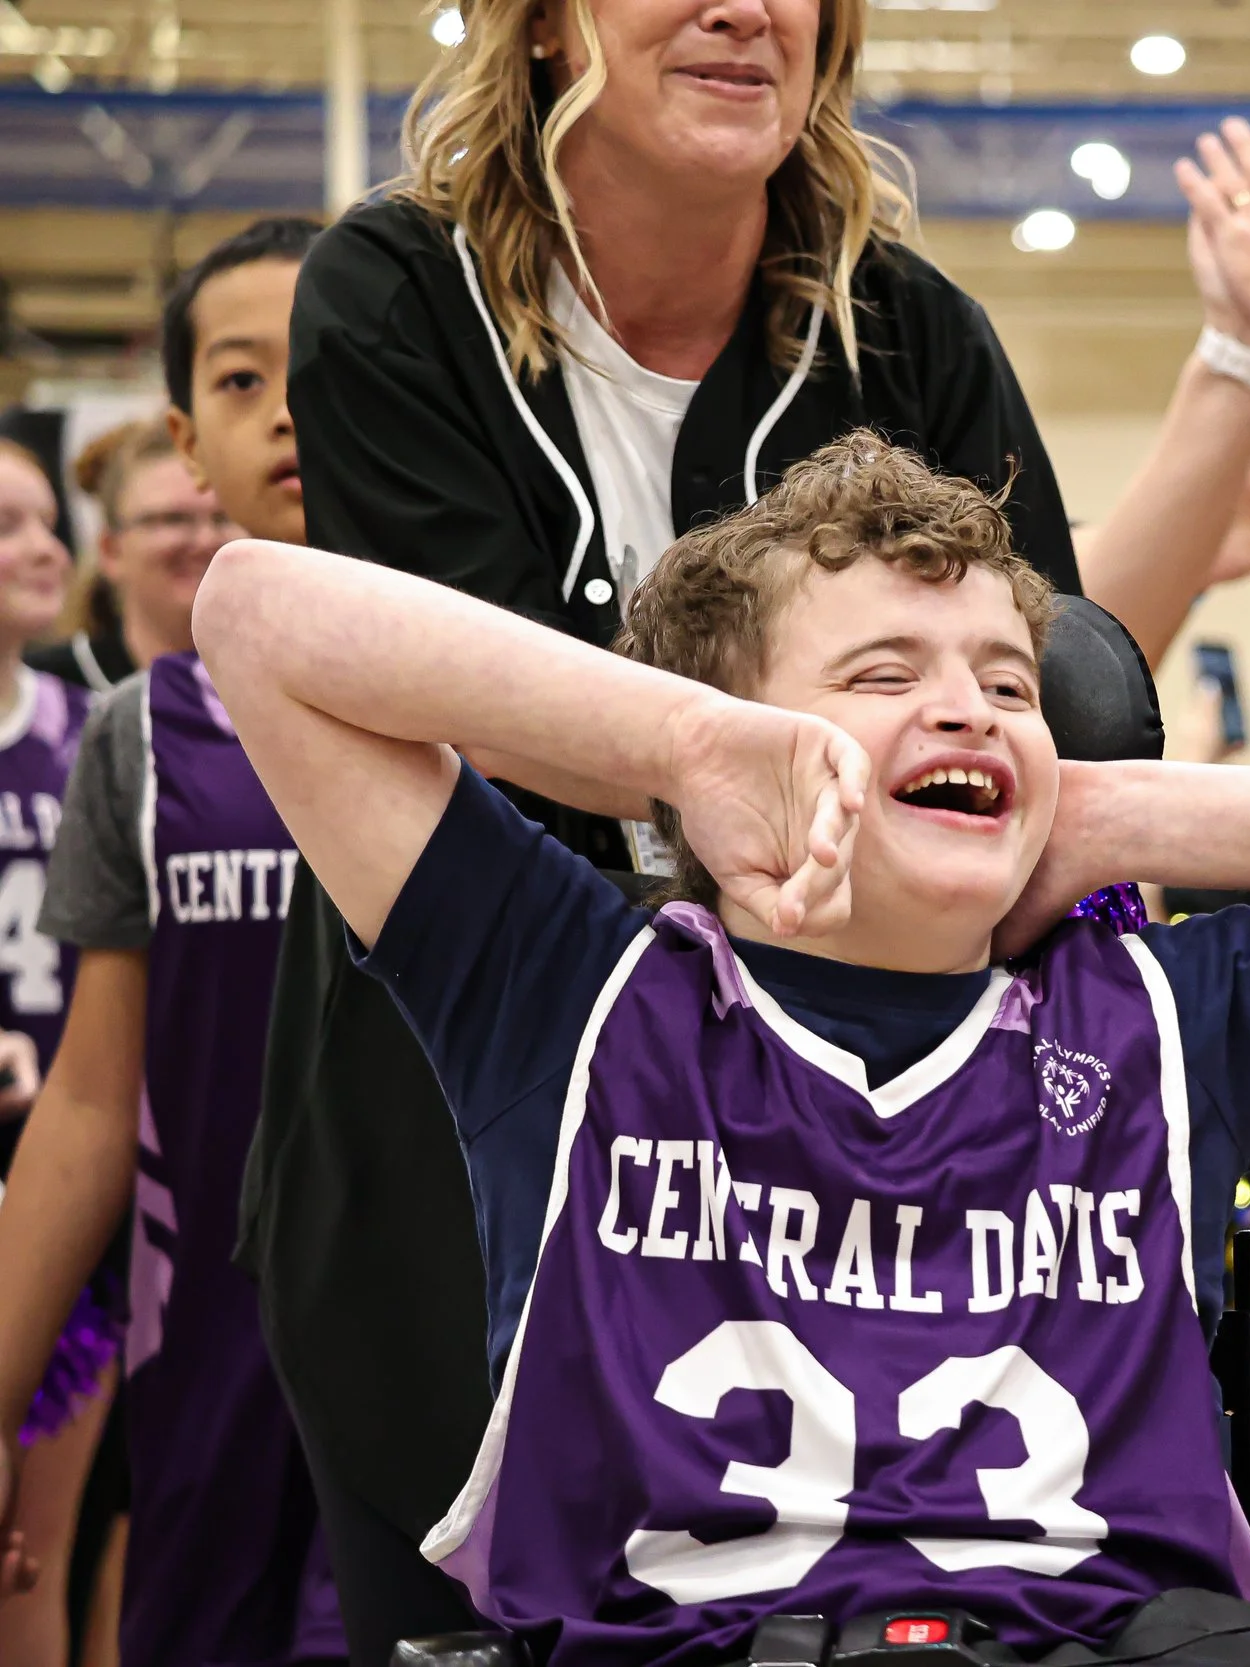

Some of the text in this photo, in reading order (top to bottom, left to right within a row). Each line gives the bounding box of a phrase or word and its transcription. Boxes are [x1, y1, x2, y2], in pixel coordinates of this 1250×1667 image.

[1054, 1038, 1111, 1081] LYMPICS
[966, 1183, 1145, 1313] DAVIS
[624, 1319, 1109, 1606] 33
